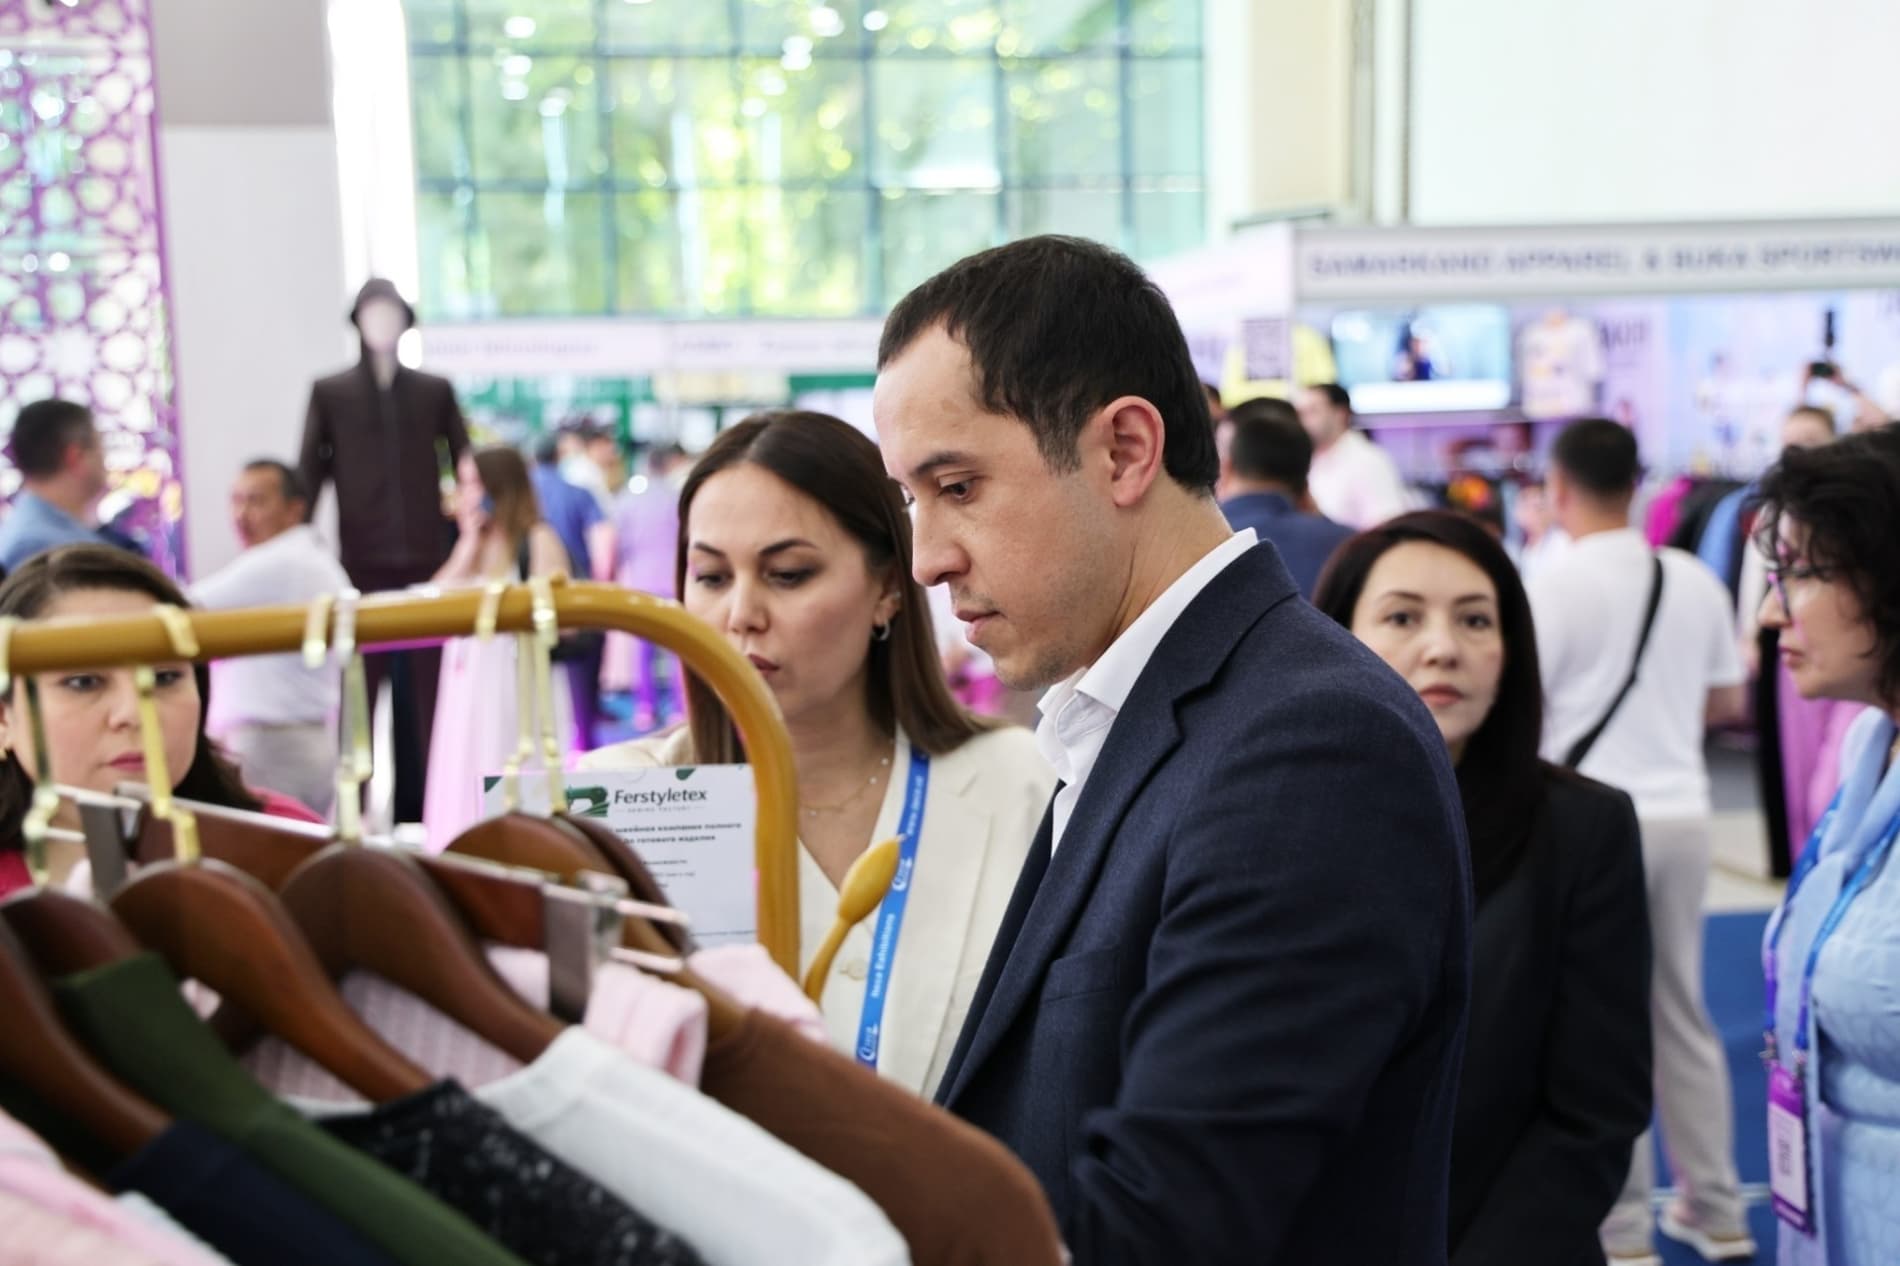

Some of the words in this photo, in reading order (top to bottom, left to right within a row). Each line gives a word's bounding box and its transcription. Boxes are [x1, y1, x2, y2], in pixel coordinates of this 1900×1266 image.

[1311, 253, 1491, 277] SAMARKAND
[1506, 249, 1628, 273] APPAREL
[614, 787, 707, 806] Ferstyletex
[875, 913, 896, 971] Exhibitions
